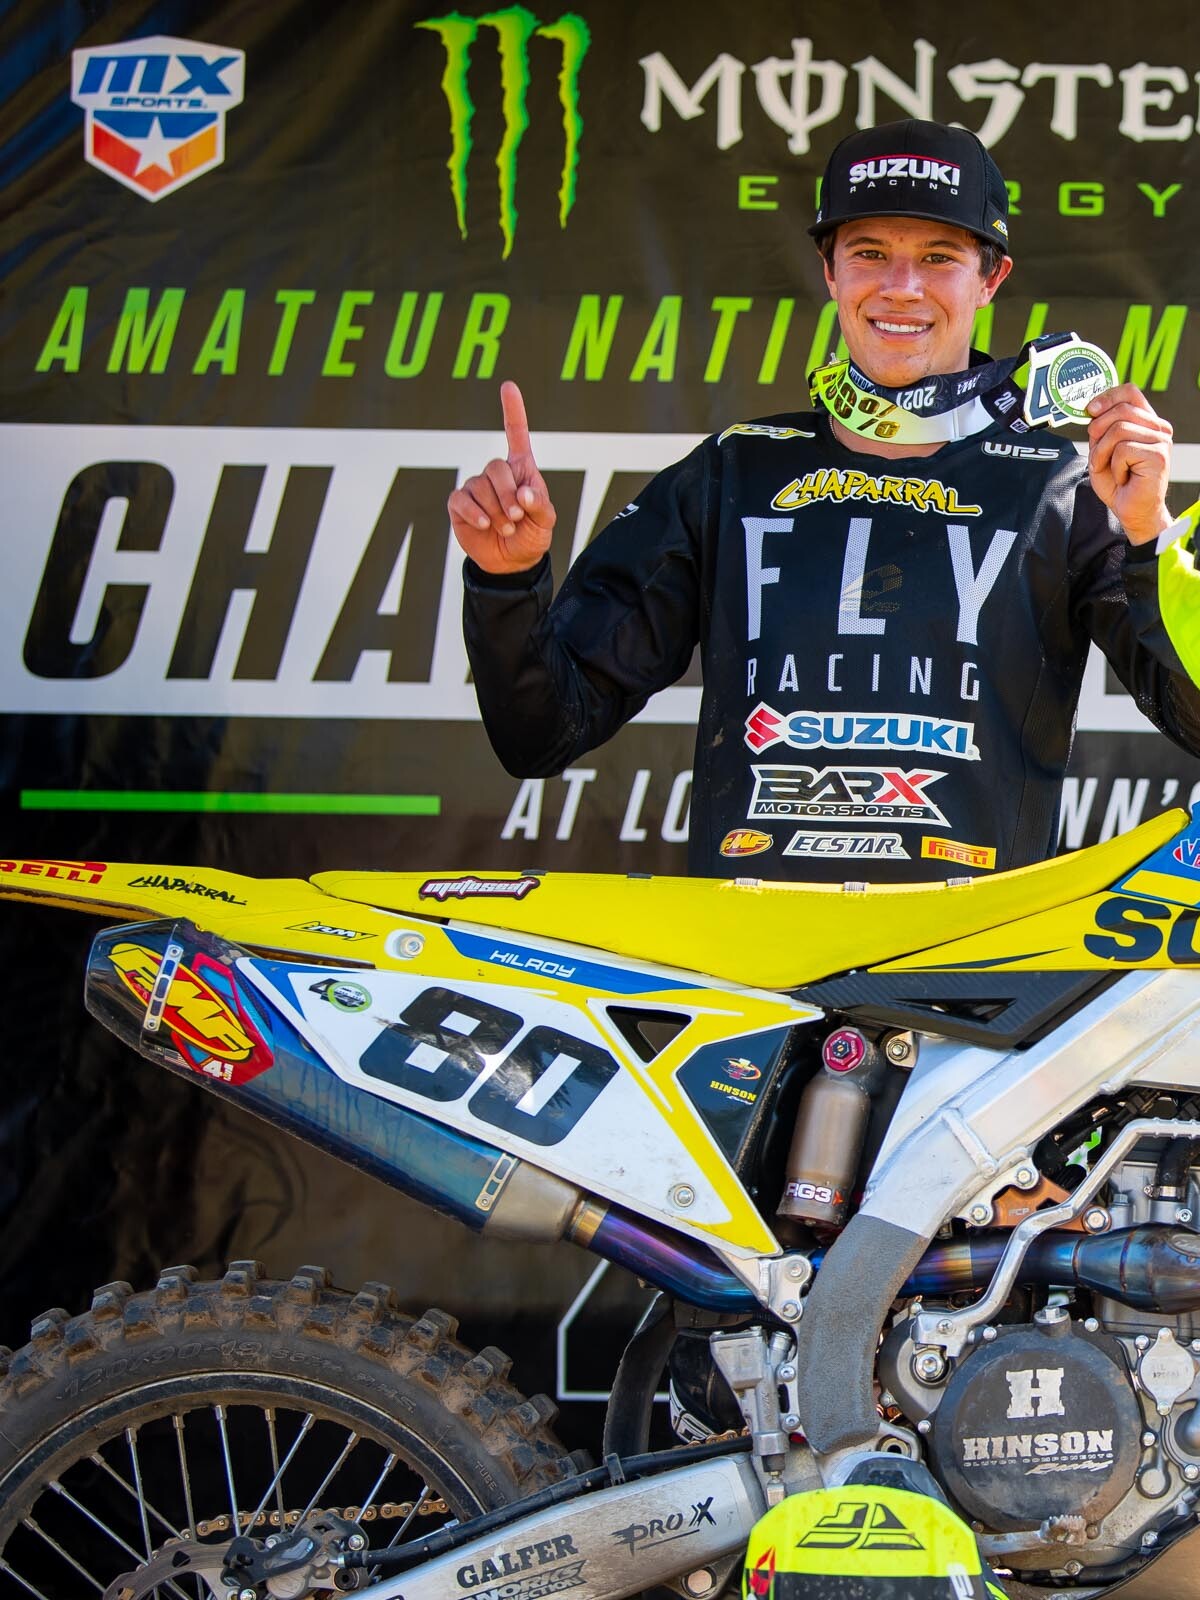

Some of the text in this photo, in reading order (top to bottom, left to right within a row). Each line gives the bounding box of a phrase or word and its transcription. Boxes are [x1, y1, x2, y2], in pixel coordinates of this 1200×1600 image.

[78, 55, 240, 95] MX
[110, 97, 203, 108] SPORTS
[850, 158, 960, 187] SUZUKI
[850, 179, 958, 195] RACING
[35, 287, 511, 379] AMATEUR
[981, 441, 1061, 460] WPS
[771, 468, 982, 516] CHAPARRAL
[742, 516, 1019, 646] FLY
[746, 653, 980, 701] RACING
[788, 712, 975, 756] SUZUKI
[501, 768, 596, 841] AT
[756, 768, 933, 805] BARX
[757, 803, 924, 818] MOTORSPORTS
[791, 835, 896, 855] ECSTAR
[928, 840, 989, 866] PIRELLI
[128, 874, 248, 906] CHAPARRAL
[489, 949, 577, 978] KILROY
[359, 986, 621, 1146] 80
[710, 1080, 758, 1102] HINSON
[1005, 1367, 1066, 1419] H
[962, 1429, 1114, 1461] HINSON
[456, 1533, 579, 1590] GALFER
